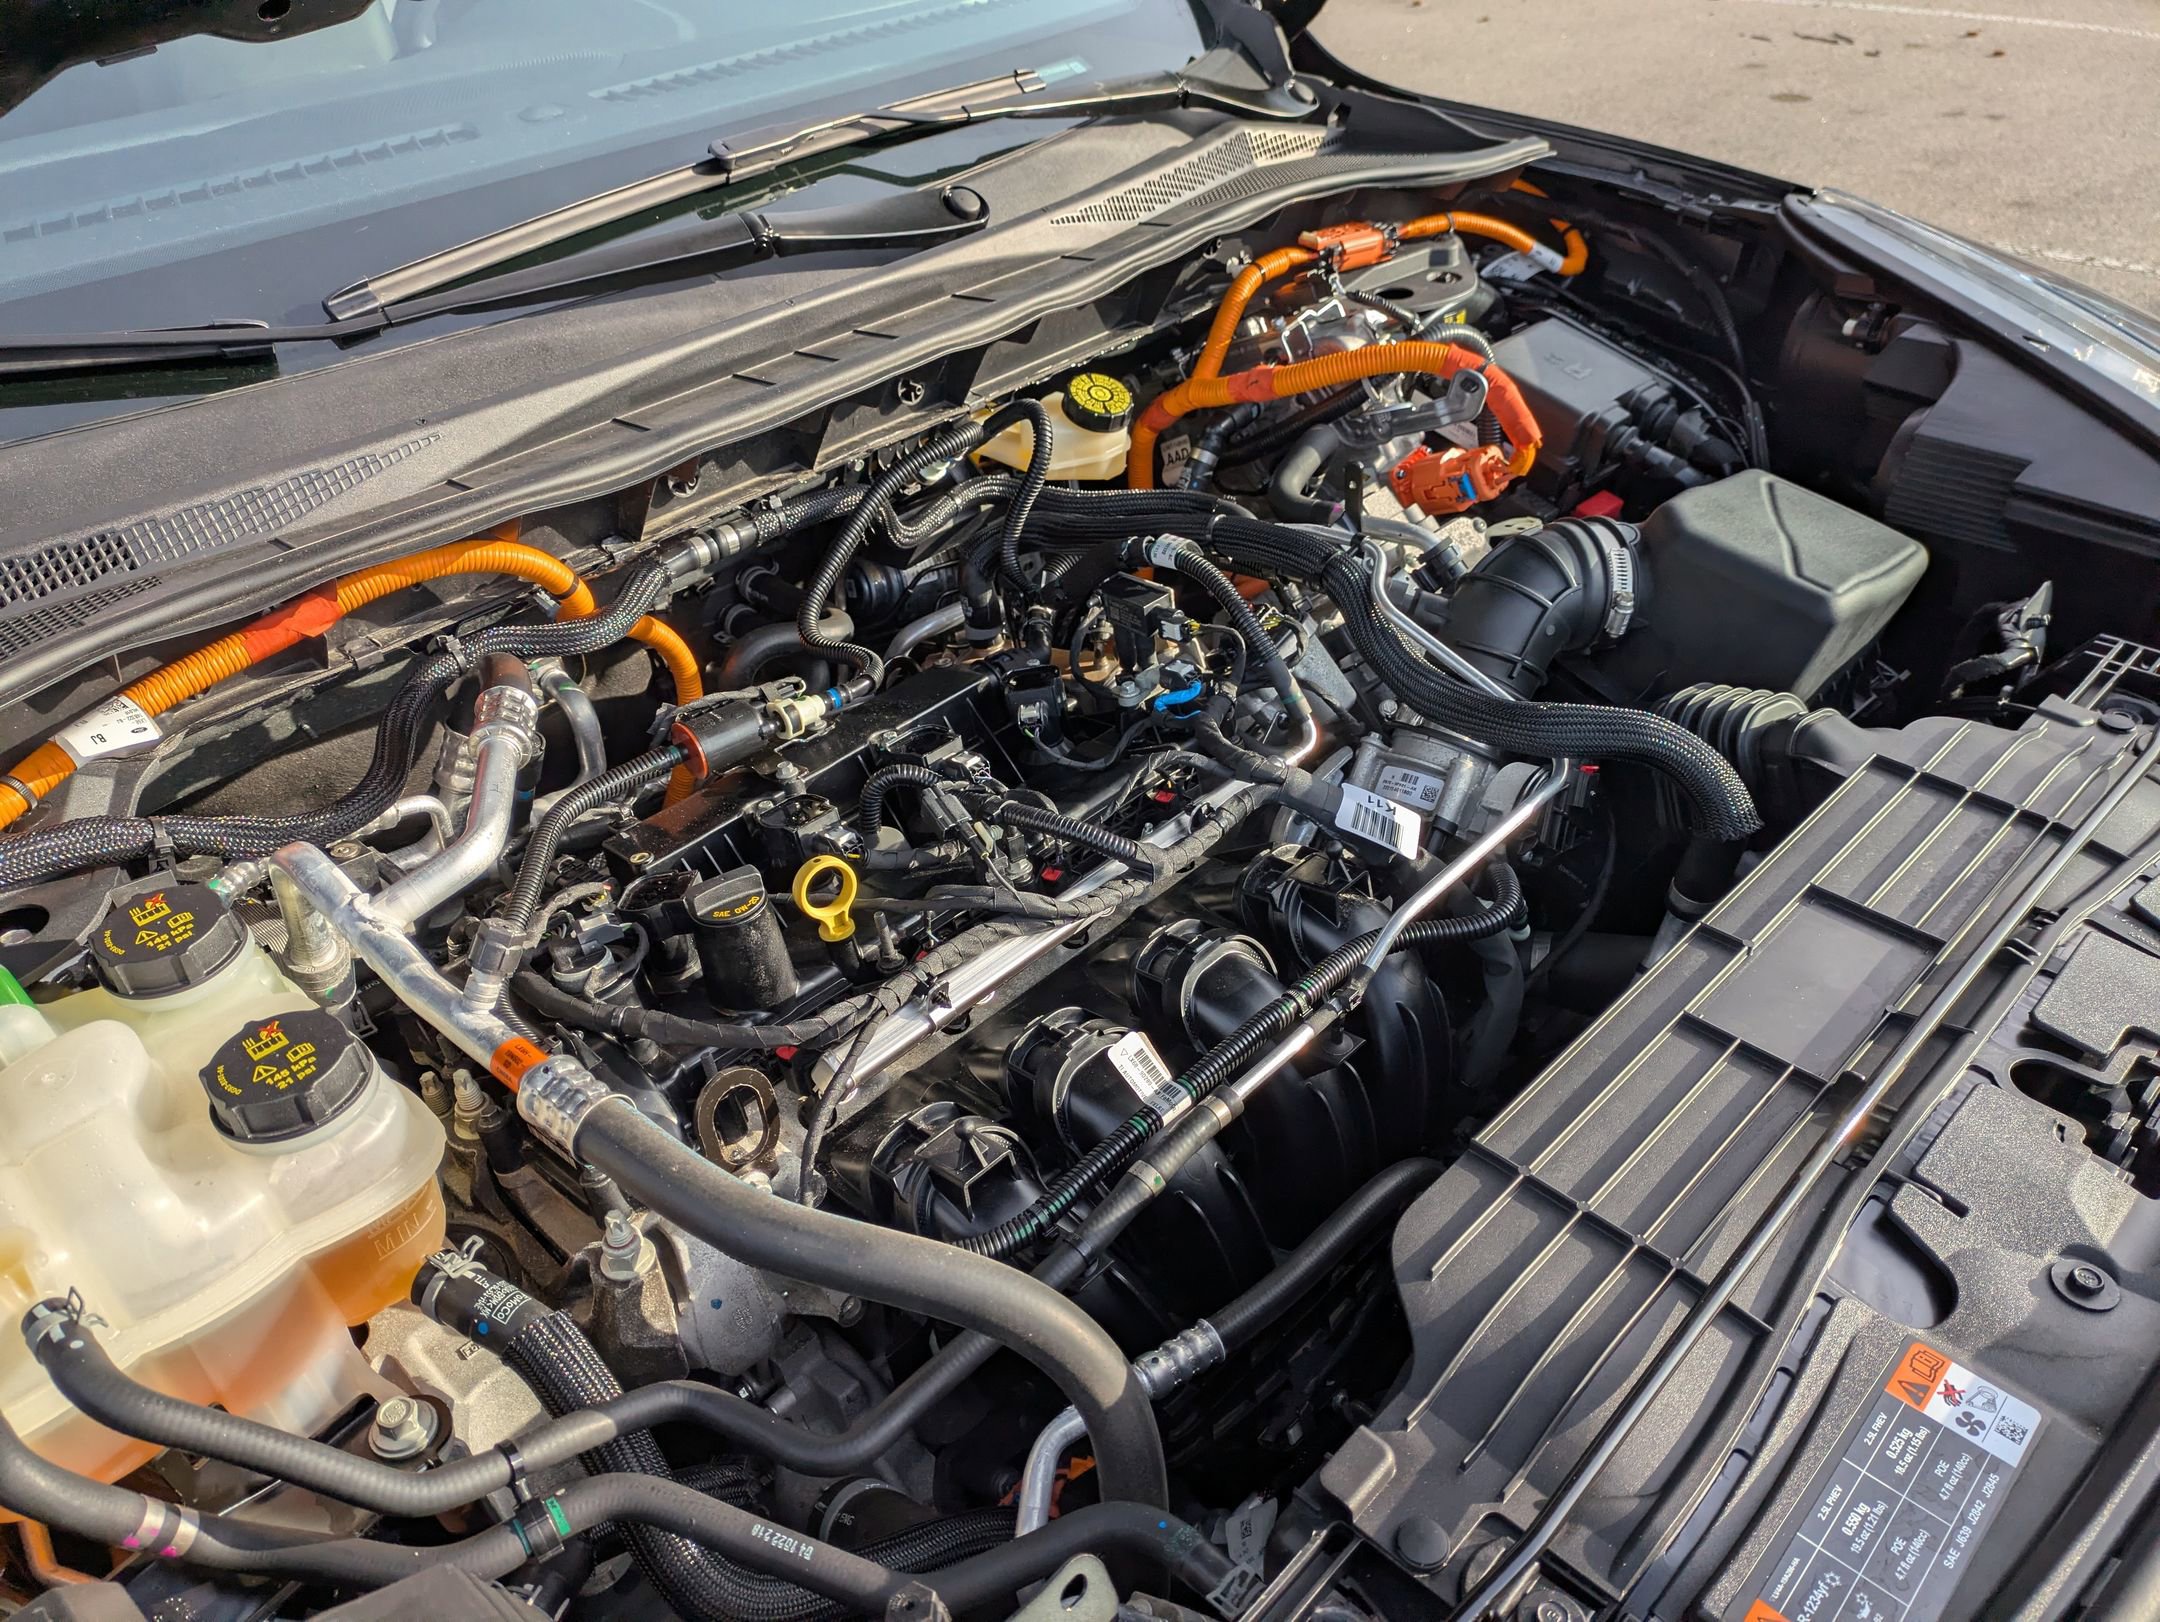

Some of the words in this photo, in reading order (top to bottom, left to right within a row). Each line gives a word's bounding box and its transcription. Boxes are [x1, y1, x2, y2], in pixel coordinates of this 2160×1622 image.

[1166, 447, 1189, 465] AAD
[90, 733, 107, 745] BJ
[1367, 795, 1397, 816] K11
[712, 910, 731, 918] SAE
[146, 933, 169, 949] 145
[170, 923, 194, 937] kPa
[156, 940, 173, 952] 21
[174, 930, 193, 944] psi
[265, 1069, 290, 1085] 145
[290, 1056, 317, 1073] kPa
[277, 1077, 294, 1090] 21
[296, 1064, 317, 1080] psi
[374, 1212, 419, 1256] MIN
[1864, 1431, 1878, 1446] 2.5L
[1872, 1412, 1887, 1432] FHEV
[1915, 1426, 1930, 1440] lbs)
[1886, 1436, 1905, 1459] 0.525
[1897, 1428, 1913, 1441] kg
[1906, 1437, 1922, 1456] (1.15
[1904, 1453, 1913, 1463] oz
[1952, 1453, 1972, 1478] (140cc)
[1894, 1460, 1908, 1475] 18.5
[1934, 1460, 1950, 1477] POE
[1949, 1472, 1960, 1485] oz
[1817, 1506, 1832, 1521] 2.5L
[1826, 1484, 1842, 1506] PHEV
[1939, 1487, 1950, 1500] 4.7
[1851, 1502, 1871, 1519] kg
[1872, 1500, 1888, 1516] lbs)
[1842, 1513, 1861, 1536] 0.550
[1863, 1513, 1879, 1532] (1.21
[1944, 1548, 1960, 1569] SAE
[1956, 1526, 1972, 1547] J639
[1968, 1500, 1986, 1525] J2842
[1982, 1473, 1999, 1498] J2845
[1860, 1530, 1870, 1540] oz
[1908, 1529, 1930, 1556] (140cc)
[1851, 1537, 1865, 1553] 19.5
[1891, 1537, 1906, 1555] POE
[1906, 1553, 1915, 1564] oz
[1895, 1566, 1907, 1580] 4.7
[1797, 1580, 1829, 1622] R-1234yf
